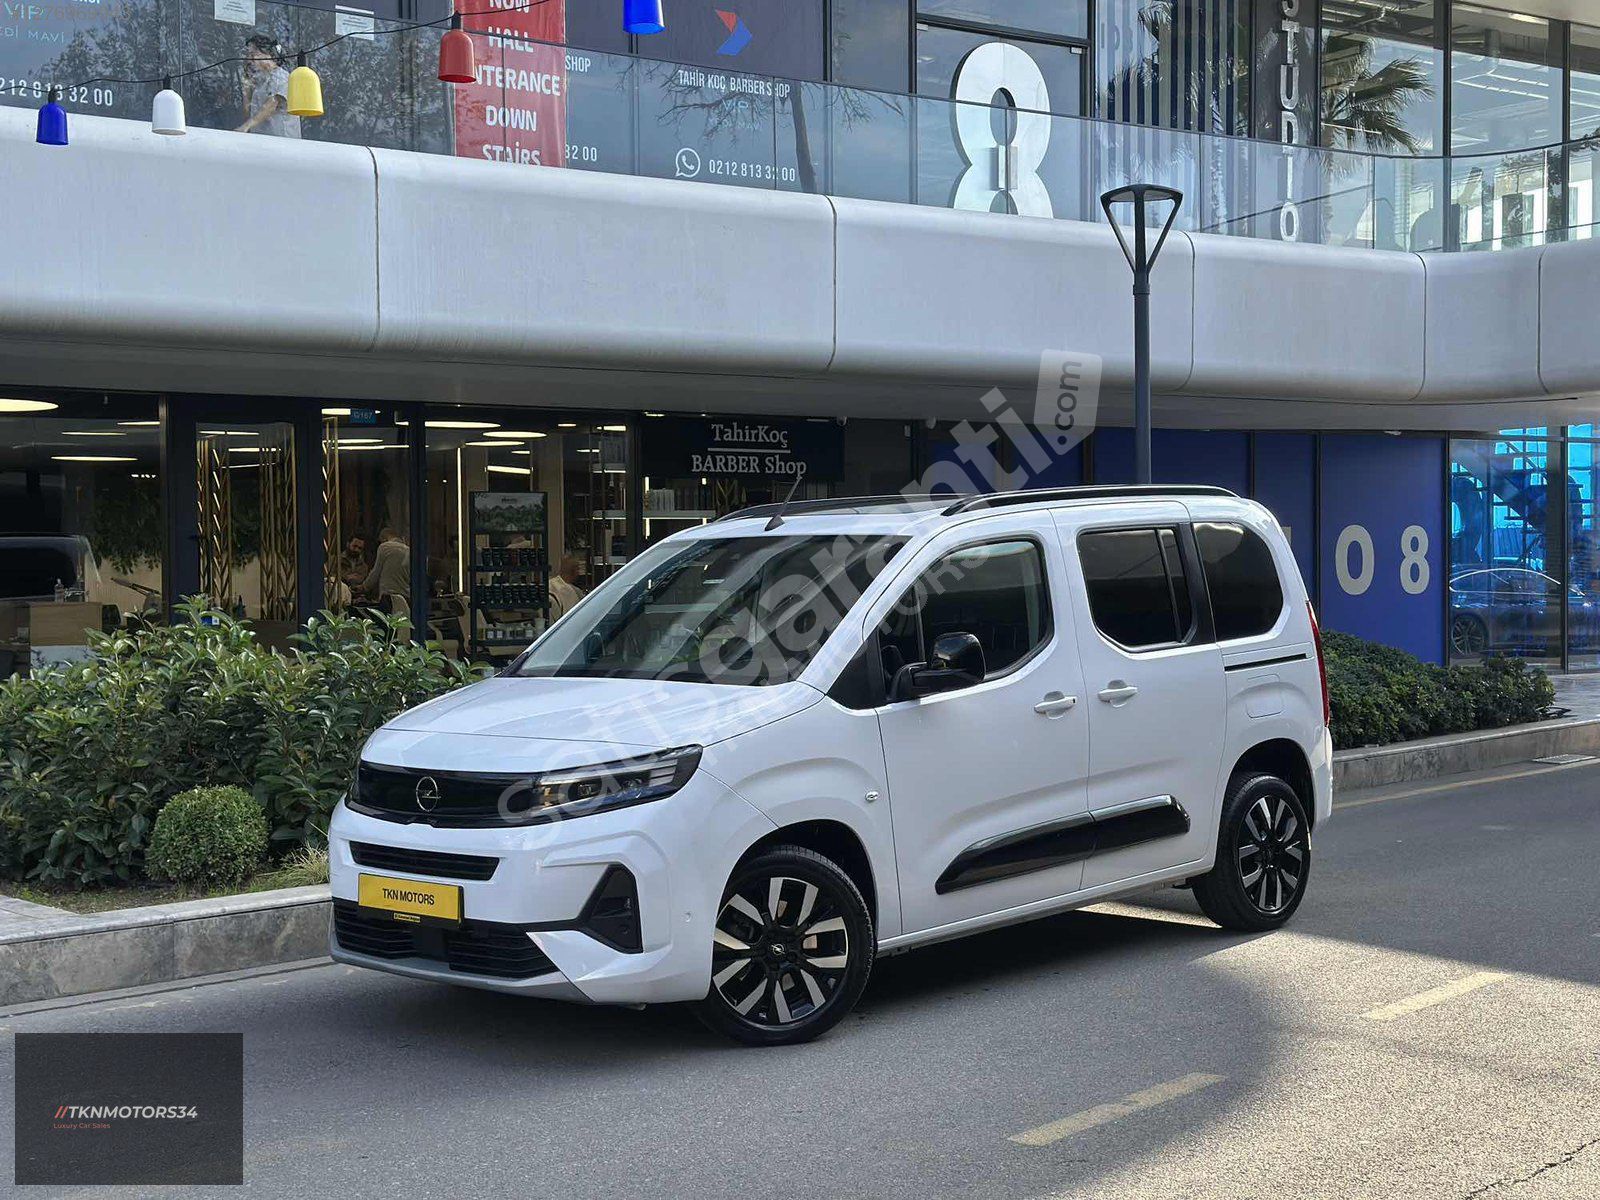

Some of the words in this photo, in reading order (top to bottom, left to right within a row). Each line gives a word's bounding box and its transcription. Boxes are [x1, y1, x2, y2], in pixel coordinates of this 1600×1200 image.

[487, 26, 534, 53] HALL
[565, 55, 591, 73] SHOP
[474, 64, 561, 97] NTERANCE
[679, 69, 705, 88] TAHİR
[707, 74, 727, 93] KOÇ
[730, 77, 765, 95] BARBER
[69, 85, 89, 104] 32
[93, 88, 113, 107] 00
[485, 105, 537, 132] DOWN
[582, 146, 598, 162] 00
[709, 159, 738, 176] 0212
[741, 163, 762, 179] 813
[781, 167, 796, 182] 00
[711, 422, 788, 448] TahirKoç
[691, 454, 760, 473] BARBER
[765, 454, 807, 480] Shop
[382, 887, 398, 900] TKN
[399, 890, 435, 906] MOTORS
